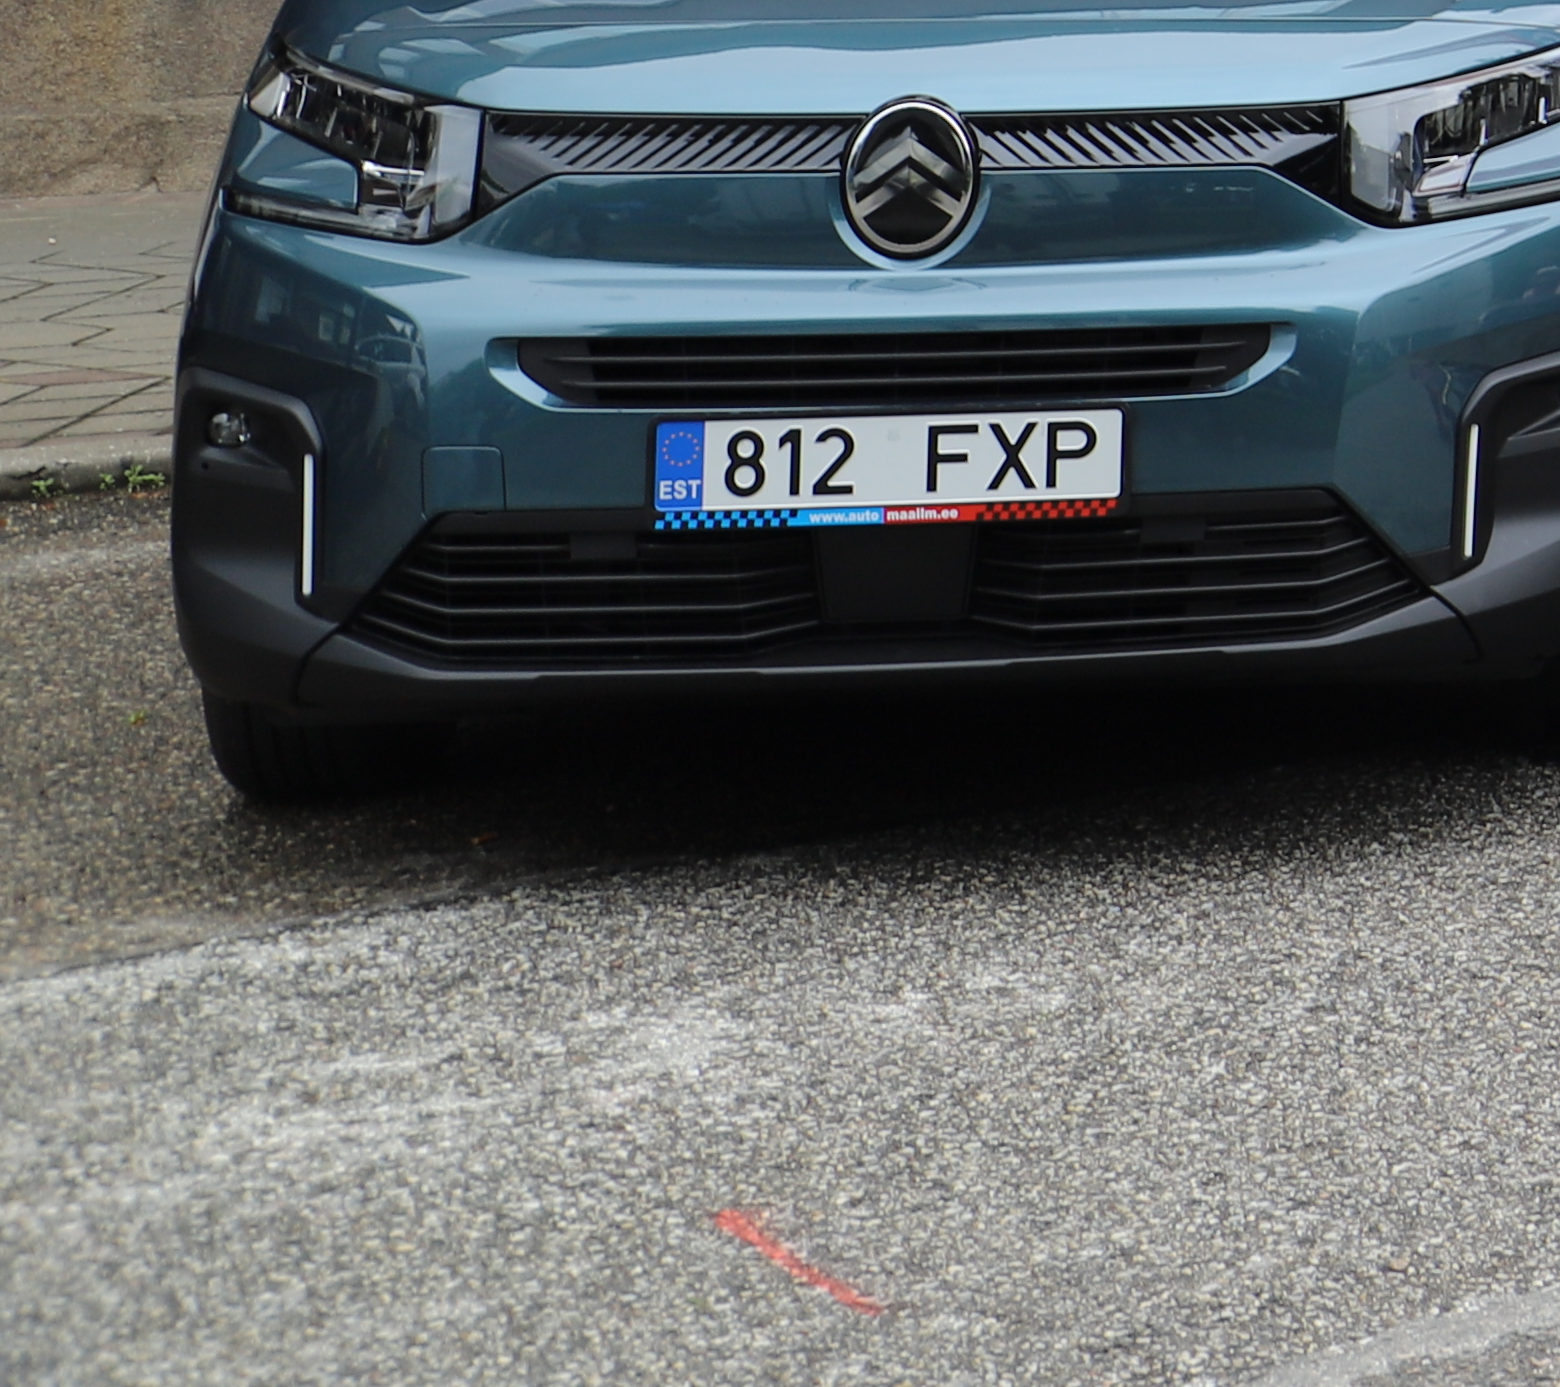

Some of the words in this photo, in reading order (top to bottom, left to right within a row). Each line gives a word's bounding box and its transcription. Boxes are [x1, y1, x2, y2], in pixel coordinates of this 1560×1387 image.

[724, 427, 856, 498] 812
[925, 421, 1099, 493] FXP
[659, 480, 701, 501] EST
